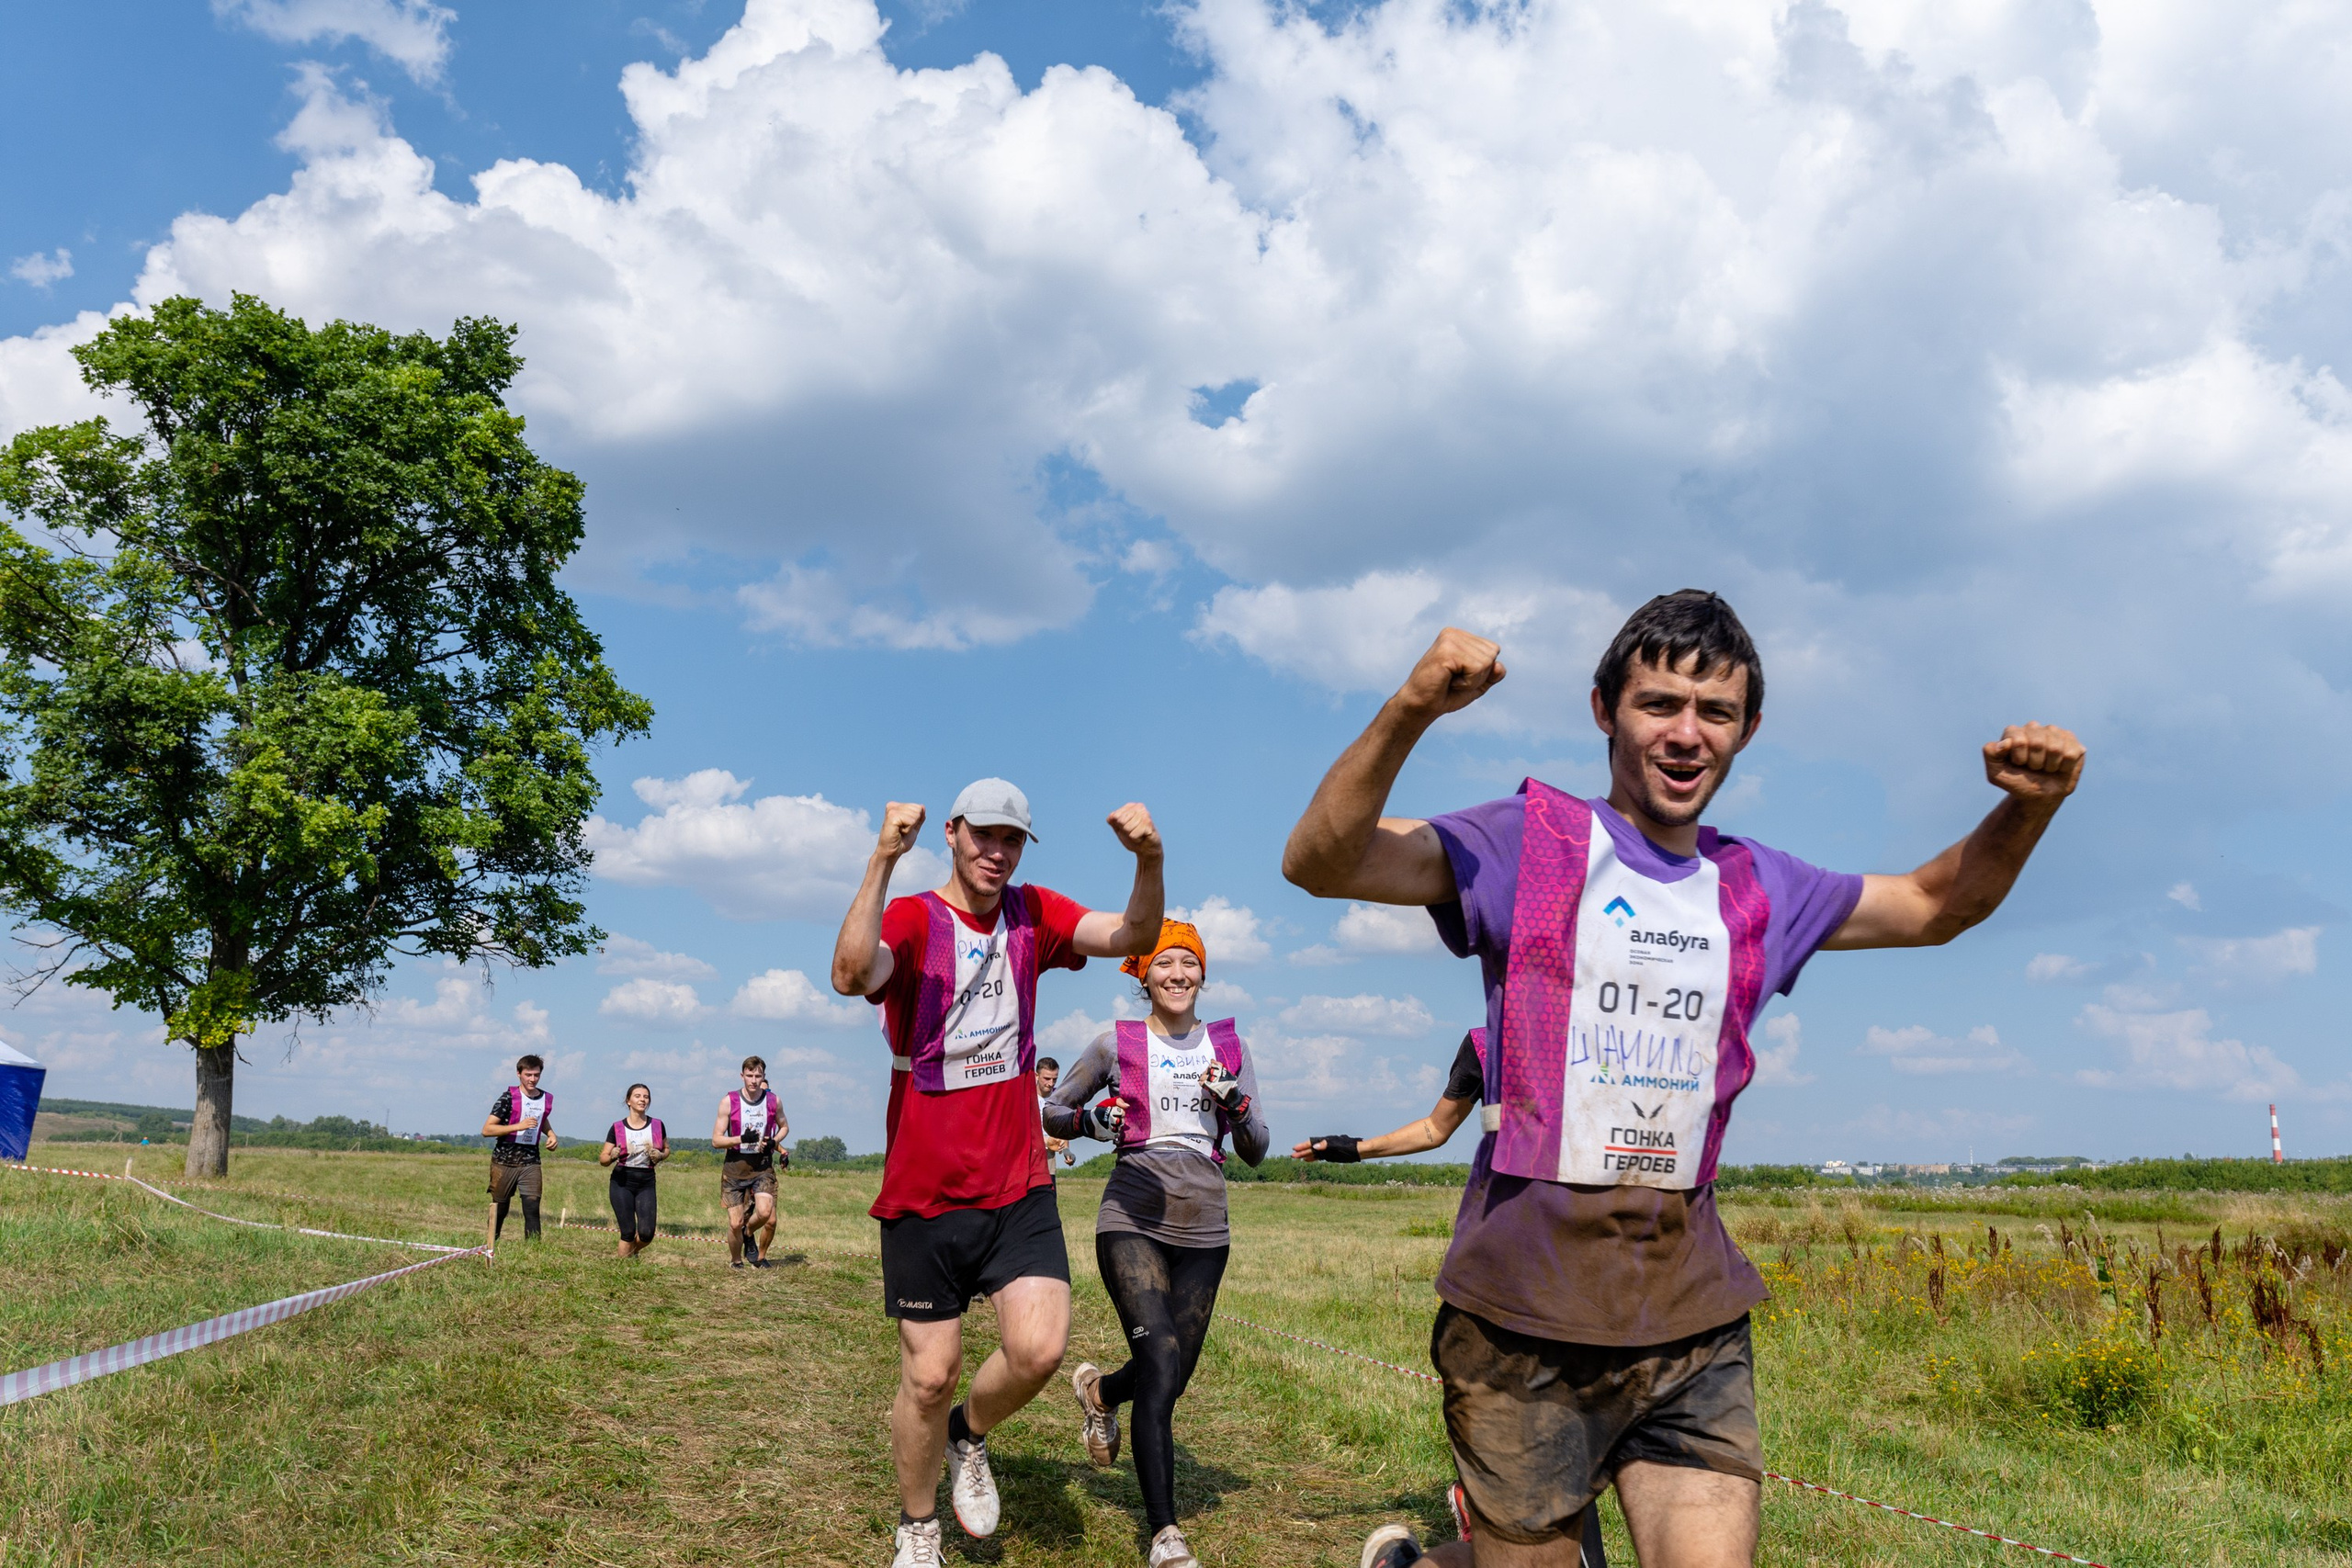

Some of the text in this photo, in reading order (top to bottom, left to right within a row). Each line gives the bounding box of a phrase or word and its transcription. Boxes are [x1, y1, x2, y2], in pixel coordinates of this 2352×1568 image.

[1630, 930, 1709, 953] алабуга
[1599, 981, 1703, 1021] 01-20
[966, 1051, 1002, 1065] ГОНКА
[965, 1064, 1006, 1079] ГЕРОЕВ
[1172, 1071, 1202, 1082] алабу
[1622, 1075, 1699, 1092] АММОНИЙ
[1160, 1097, 1211, 1112] 01-20
[1611, 1127, 1676, 1147] ГОНКА
[1604, 1153, 1676, 1174] ГЕРОЕВ
[906, 1301, 933, 1310] MASITA
